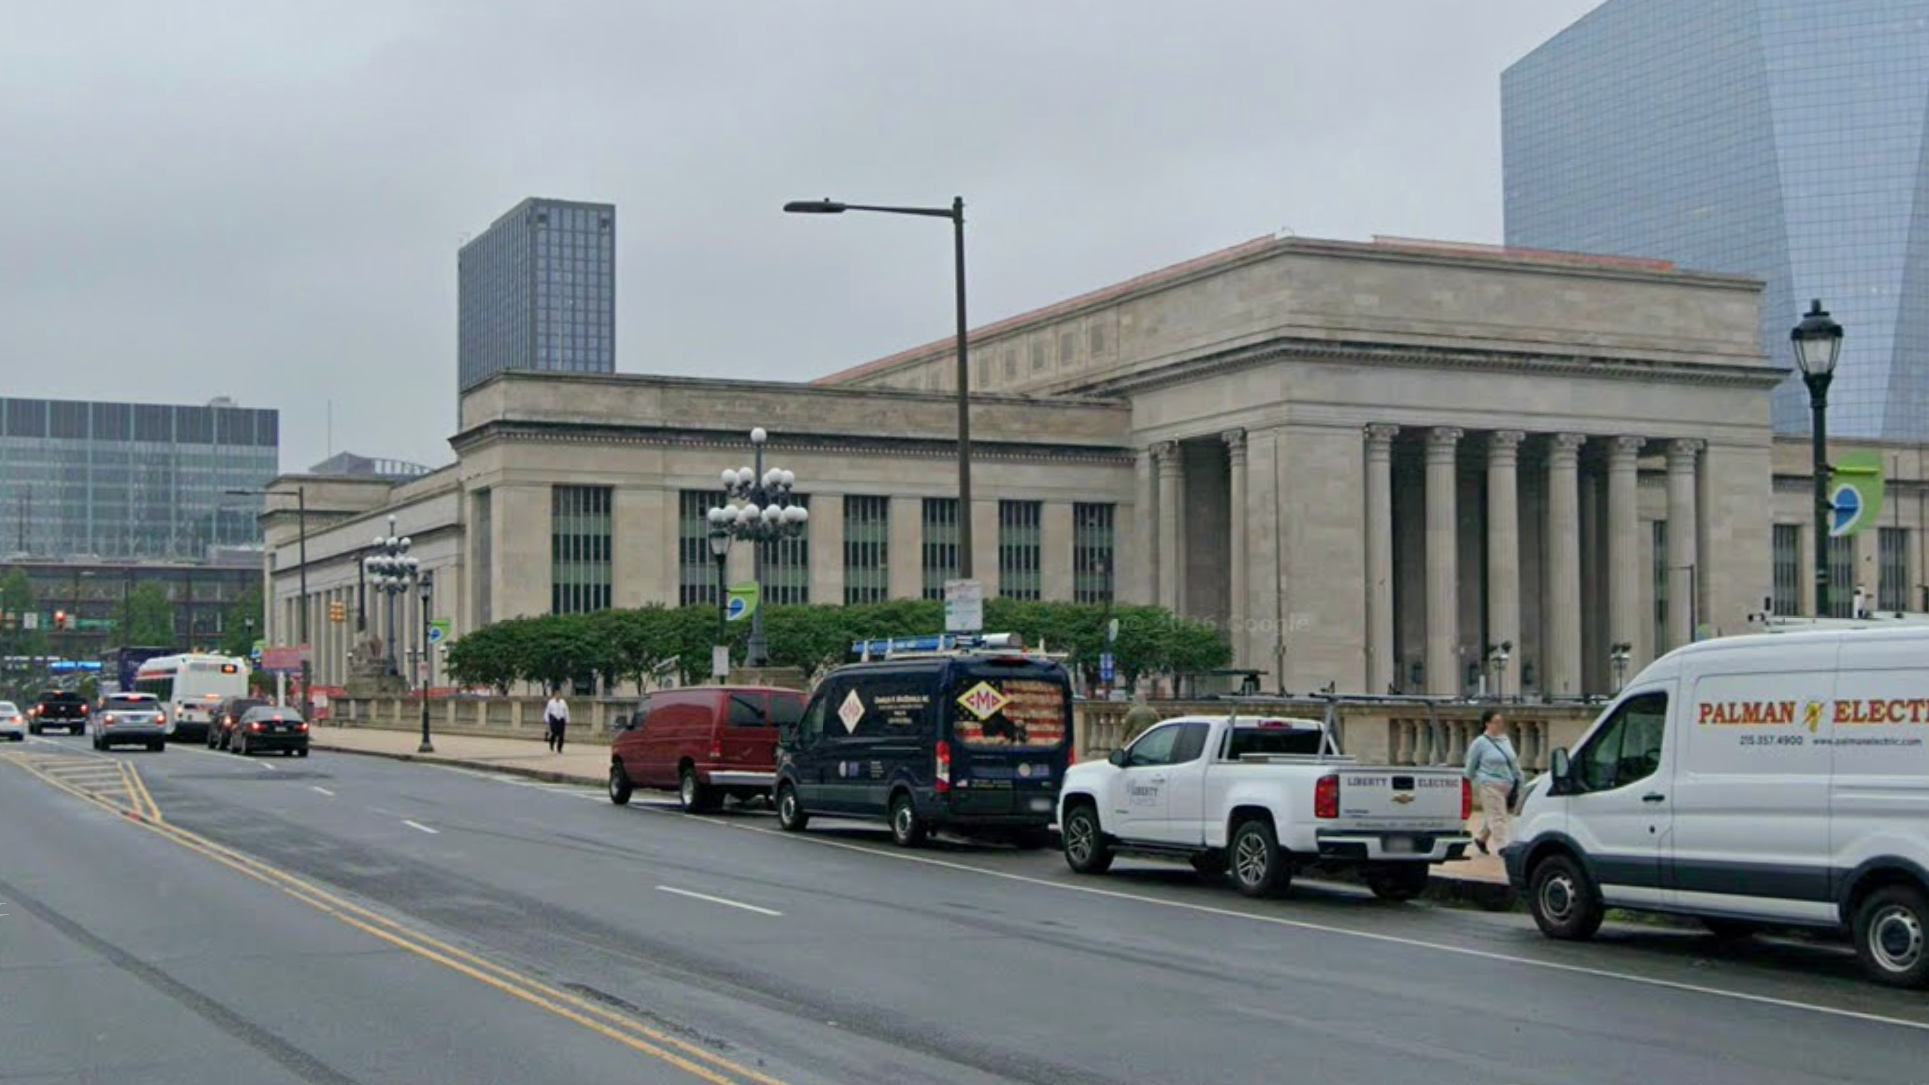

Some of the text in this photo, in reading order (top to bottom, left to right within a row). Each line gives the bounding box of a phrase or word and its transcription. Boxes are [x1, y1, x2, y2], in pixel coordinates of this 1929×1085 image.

[1698, 699, 1929, 725] PALMAN ELECT
[1740, 735, 1923, 747] 215.357.4900 www.palmanelectric.com
[1347, 777, 1460, 788] LIBERTY ELECTRIC
